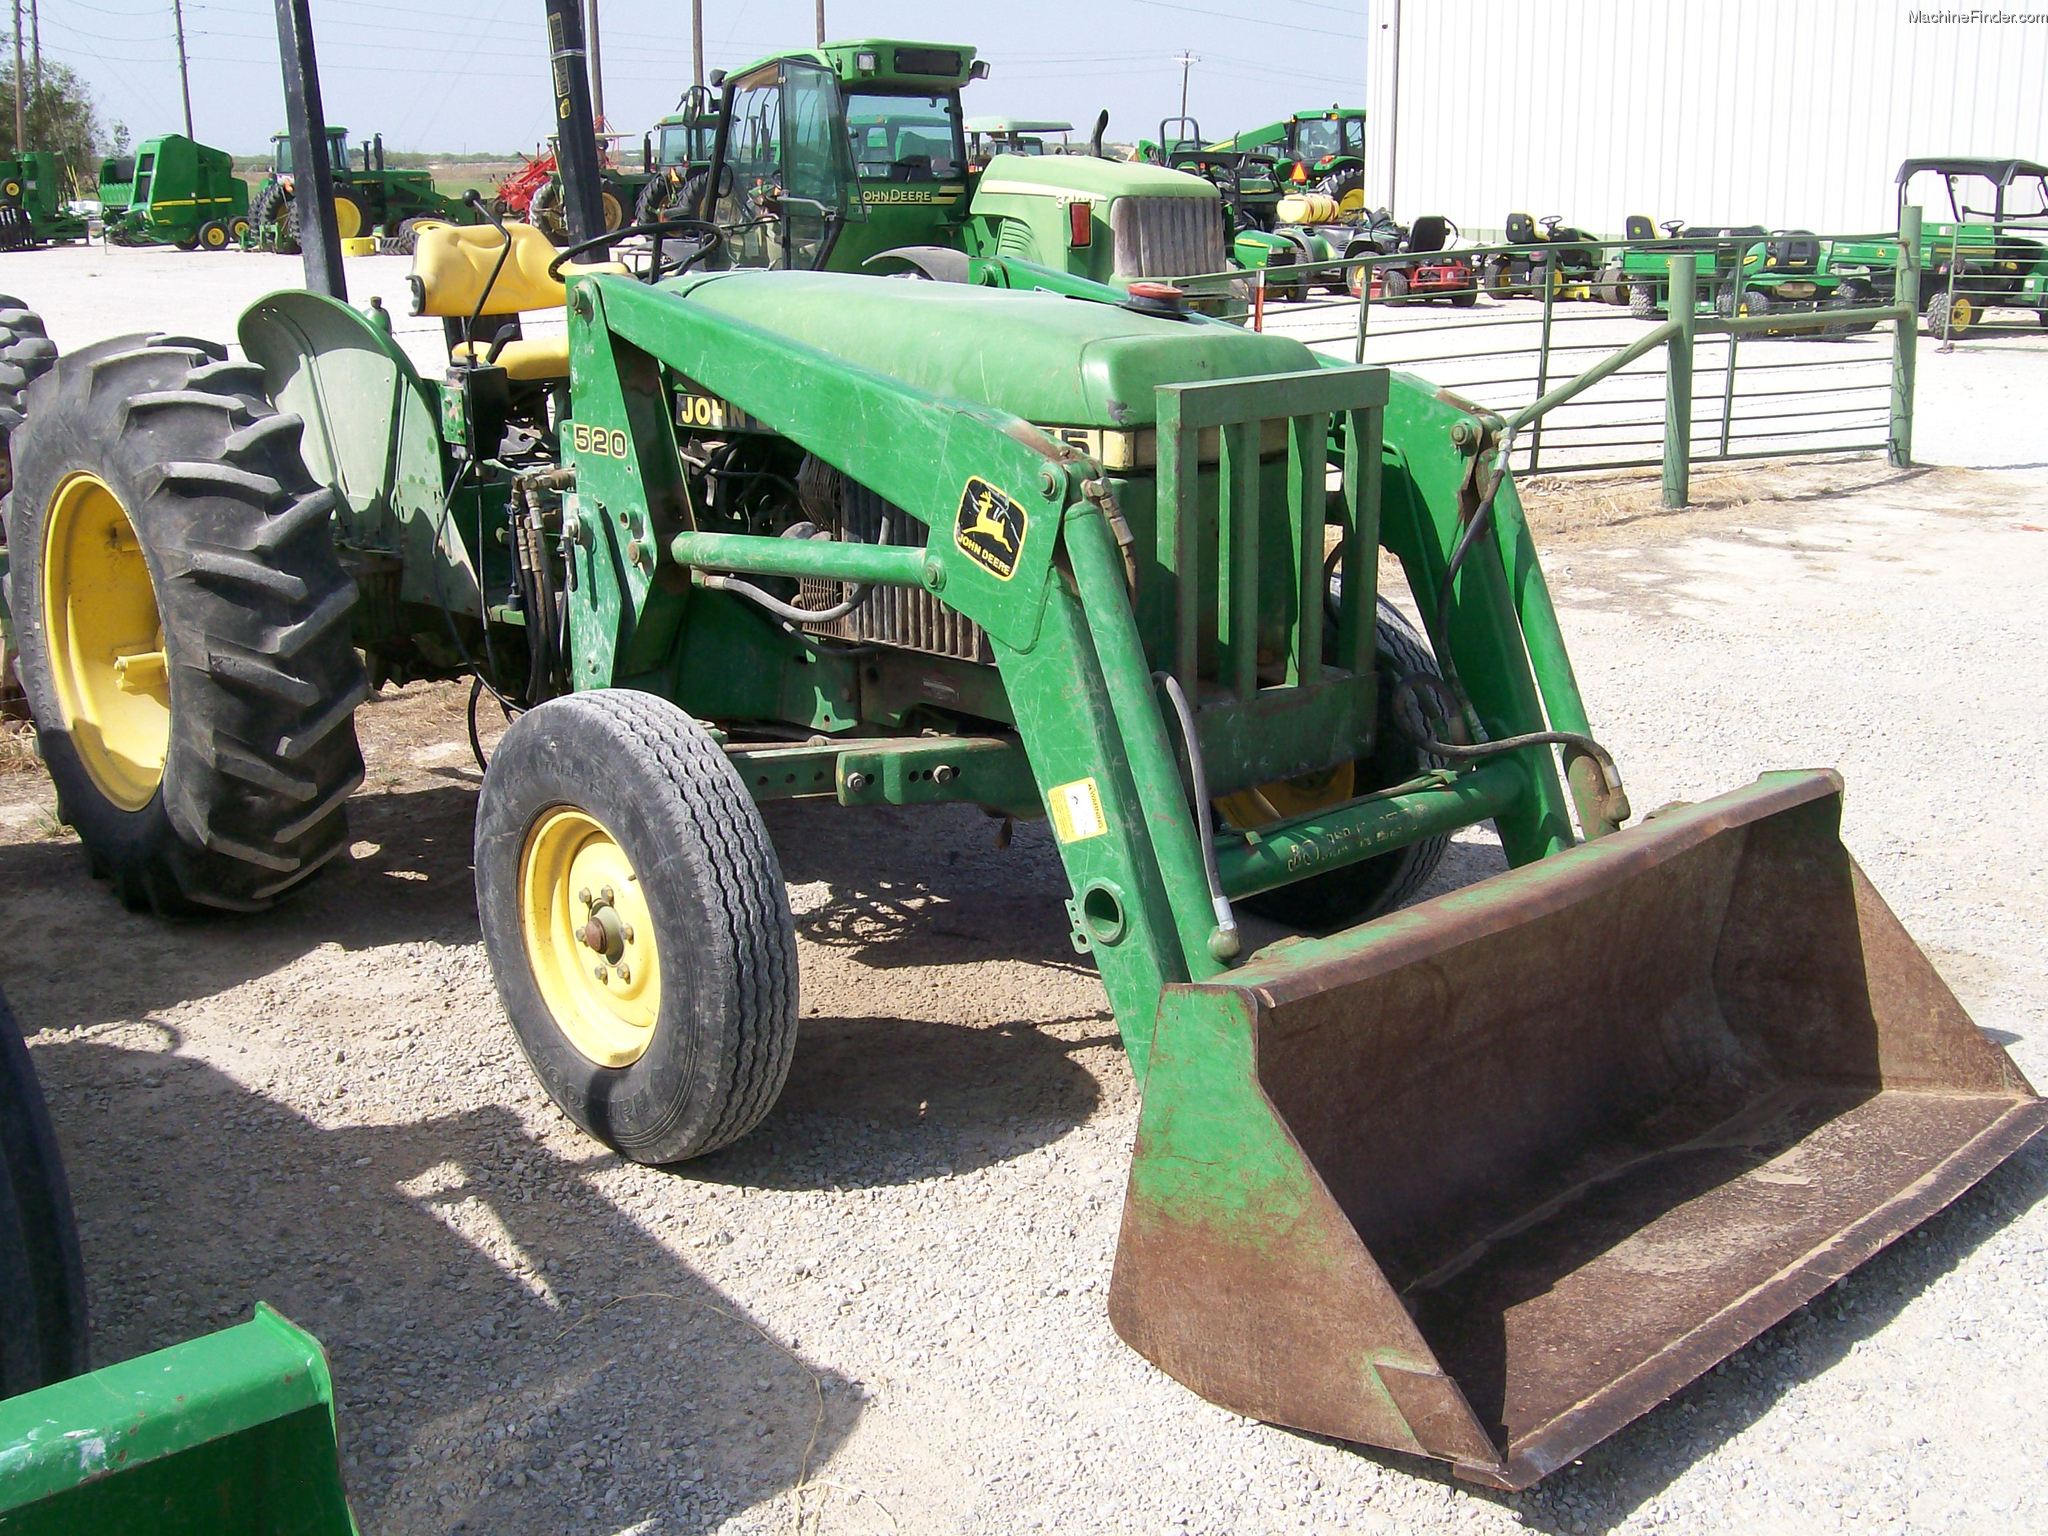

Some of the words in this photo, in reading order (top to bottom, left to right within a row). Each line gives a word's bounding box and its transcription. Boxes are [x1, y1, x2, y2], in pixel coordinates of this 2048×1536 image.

[862, 190, 889, 201] OHN
[890, 189, 932, 201] DEERE
[573, 424, 628, 459] 520
[957, 533, 982, 556] JOHN
[982, 548, 1012, 576] DEERE
